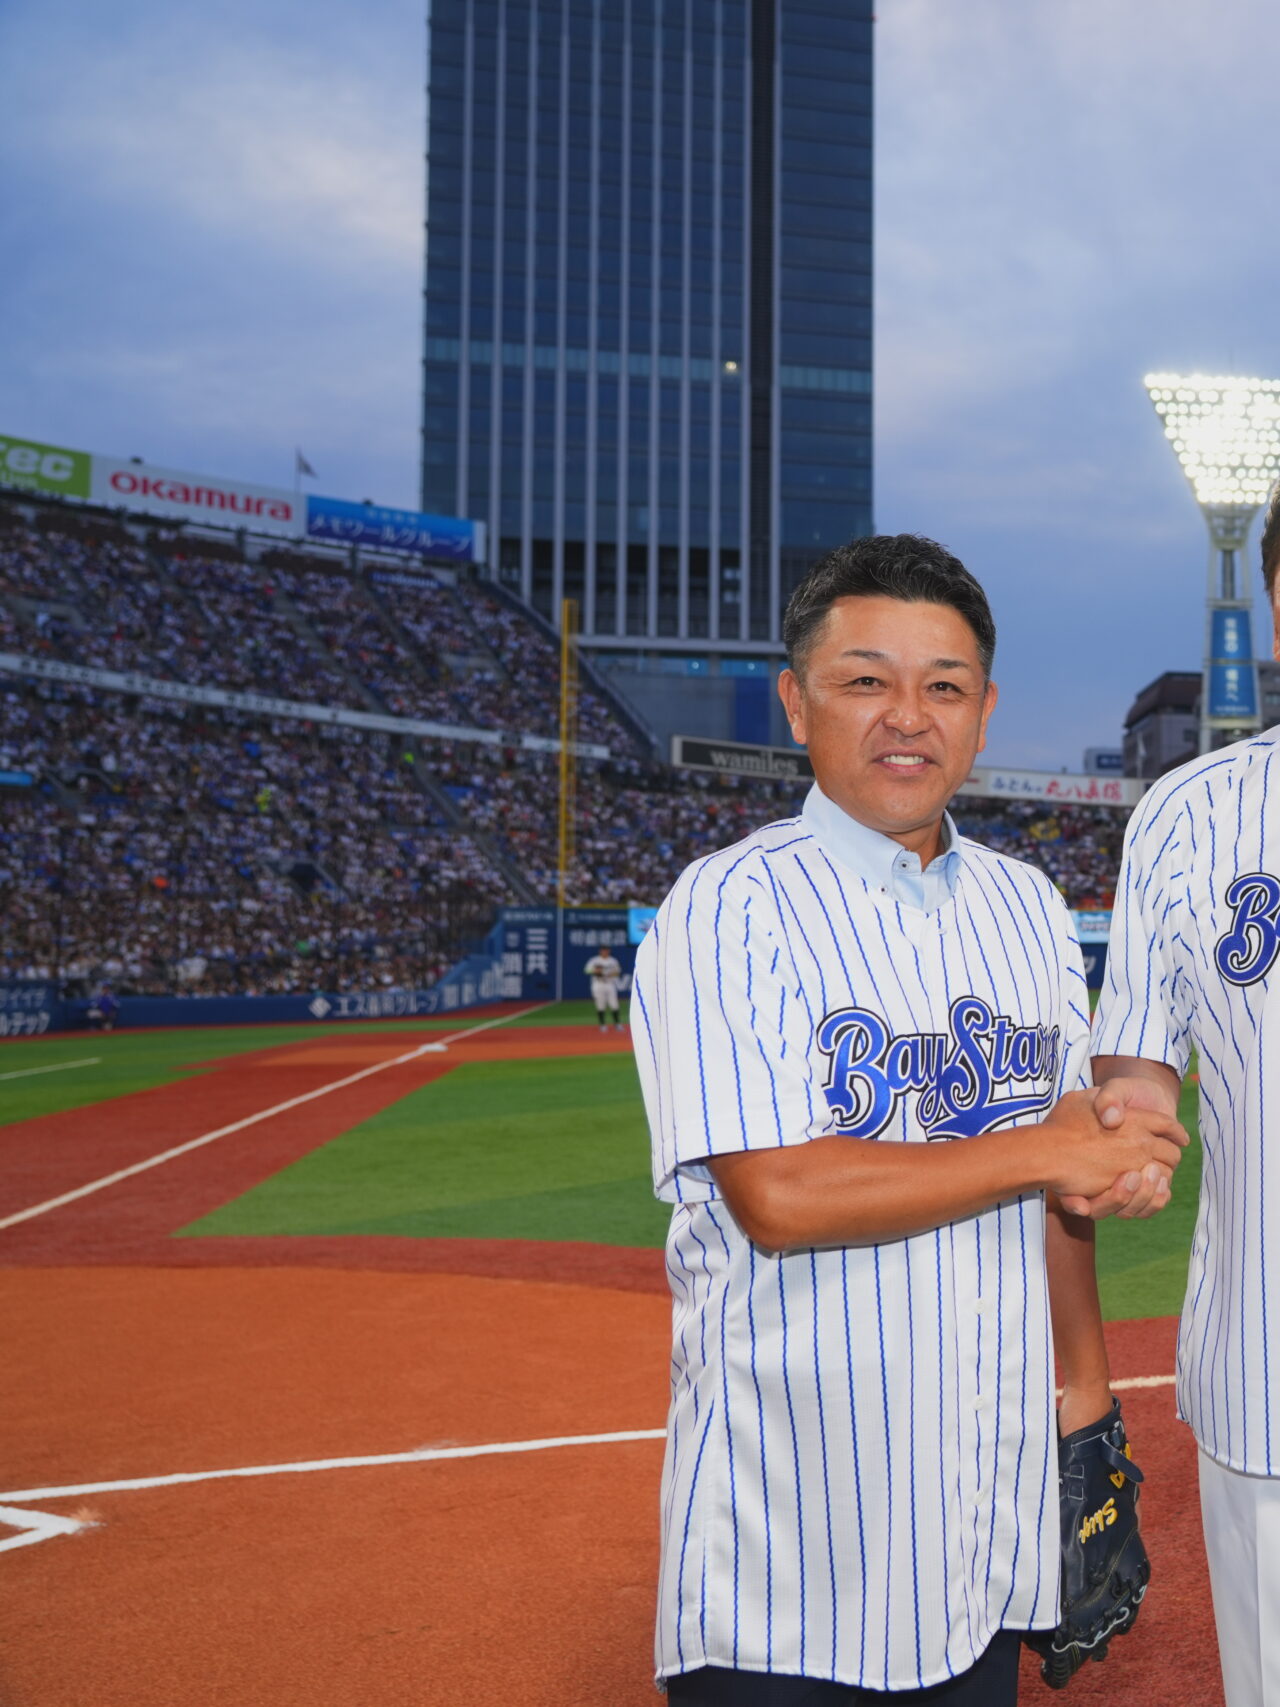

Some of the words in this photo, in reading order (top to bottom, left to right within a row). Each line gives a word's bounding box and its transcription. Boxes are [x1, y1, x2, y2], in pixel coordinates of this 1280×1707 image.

[0, 442, 75, 483] ec
[309, 512, 472, 553] メモワールグループ
[710, 749, 799, 776] wamiles
[816, 995, 1060, 1141] BayStars
